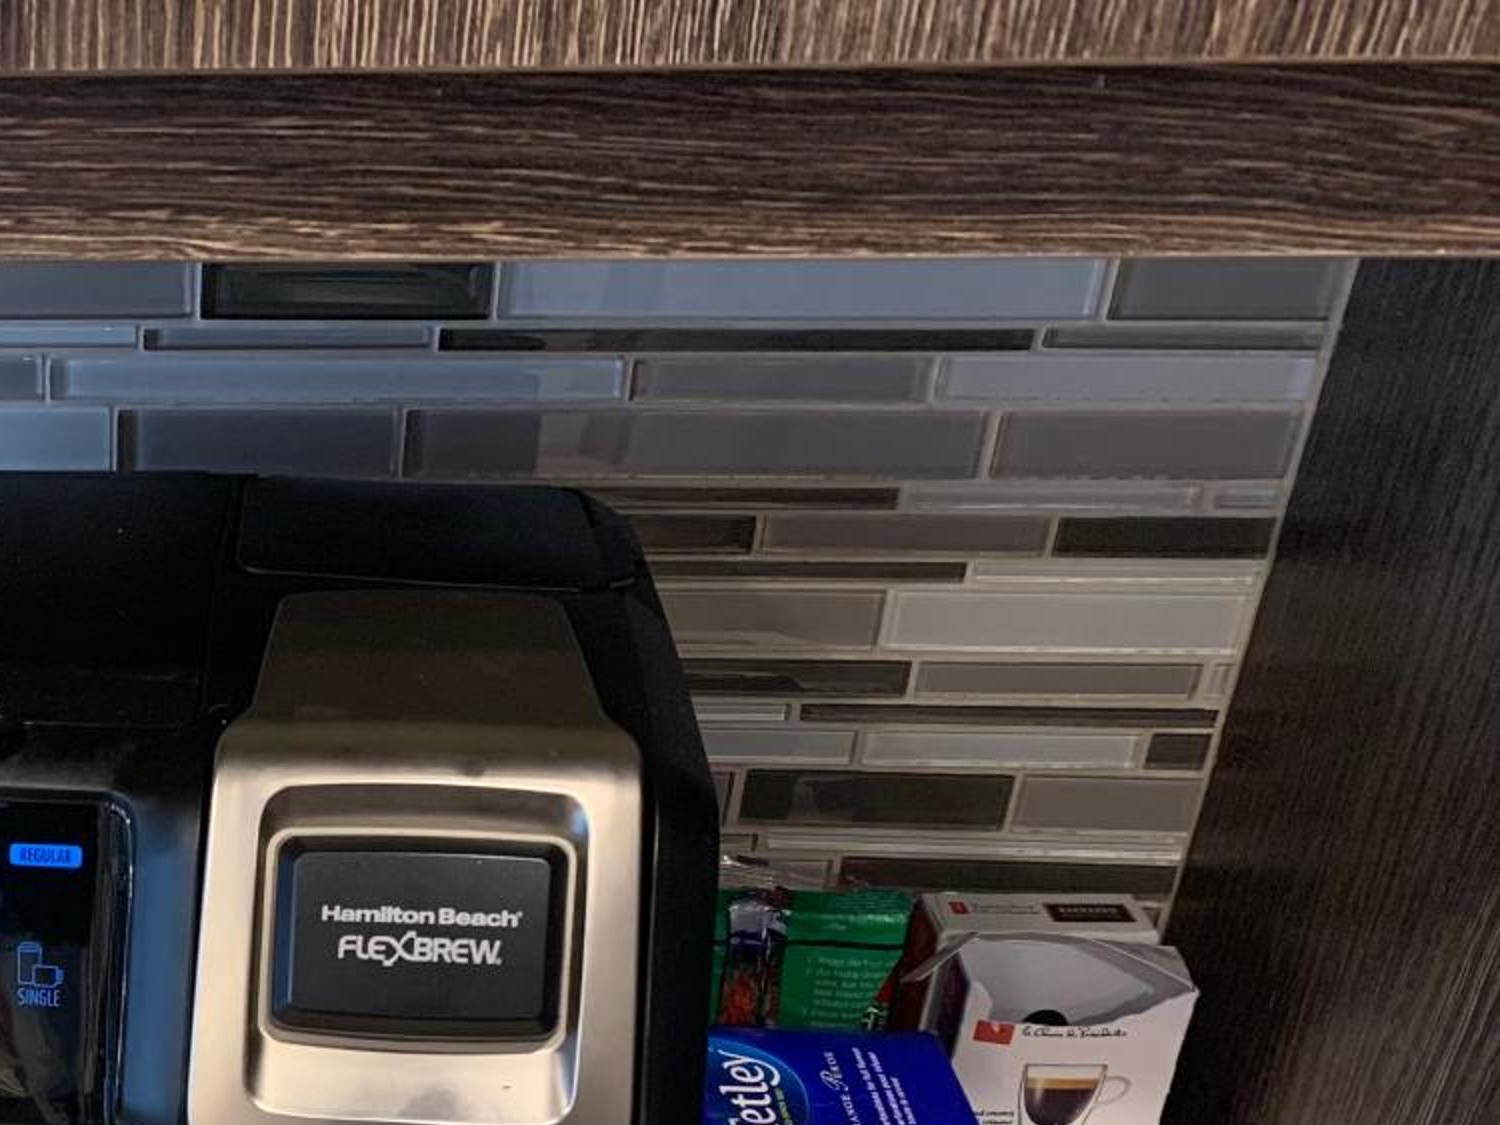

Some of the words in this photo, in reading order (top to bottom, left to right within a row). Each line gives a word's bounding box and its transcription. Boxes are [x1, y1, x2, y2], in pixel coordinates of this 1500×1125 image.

[19, 849, 72, 865] REGULAR
[321, 904, 435, 925] Hamilton
[438, 908, 522, 928] Beach
[17, 987, 61, 1008] SINGLE
